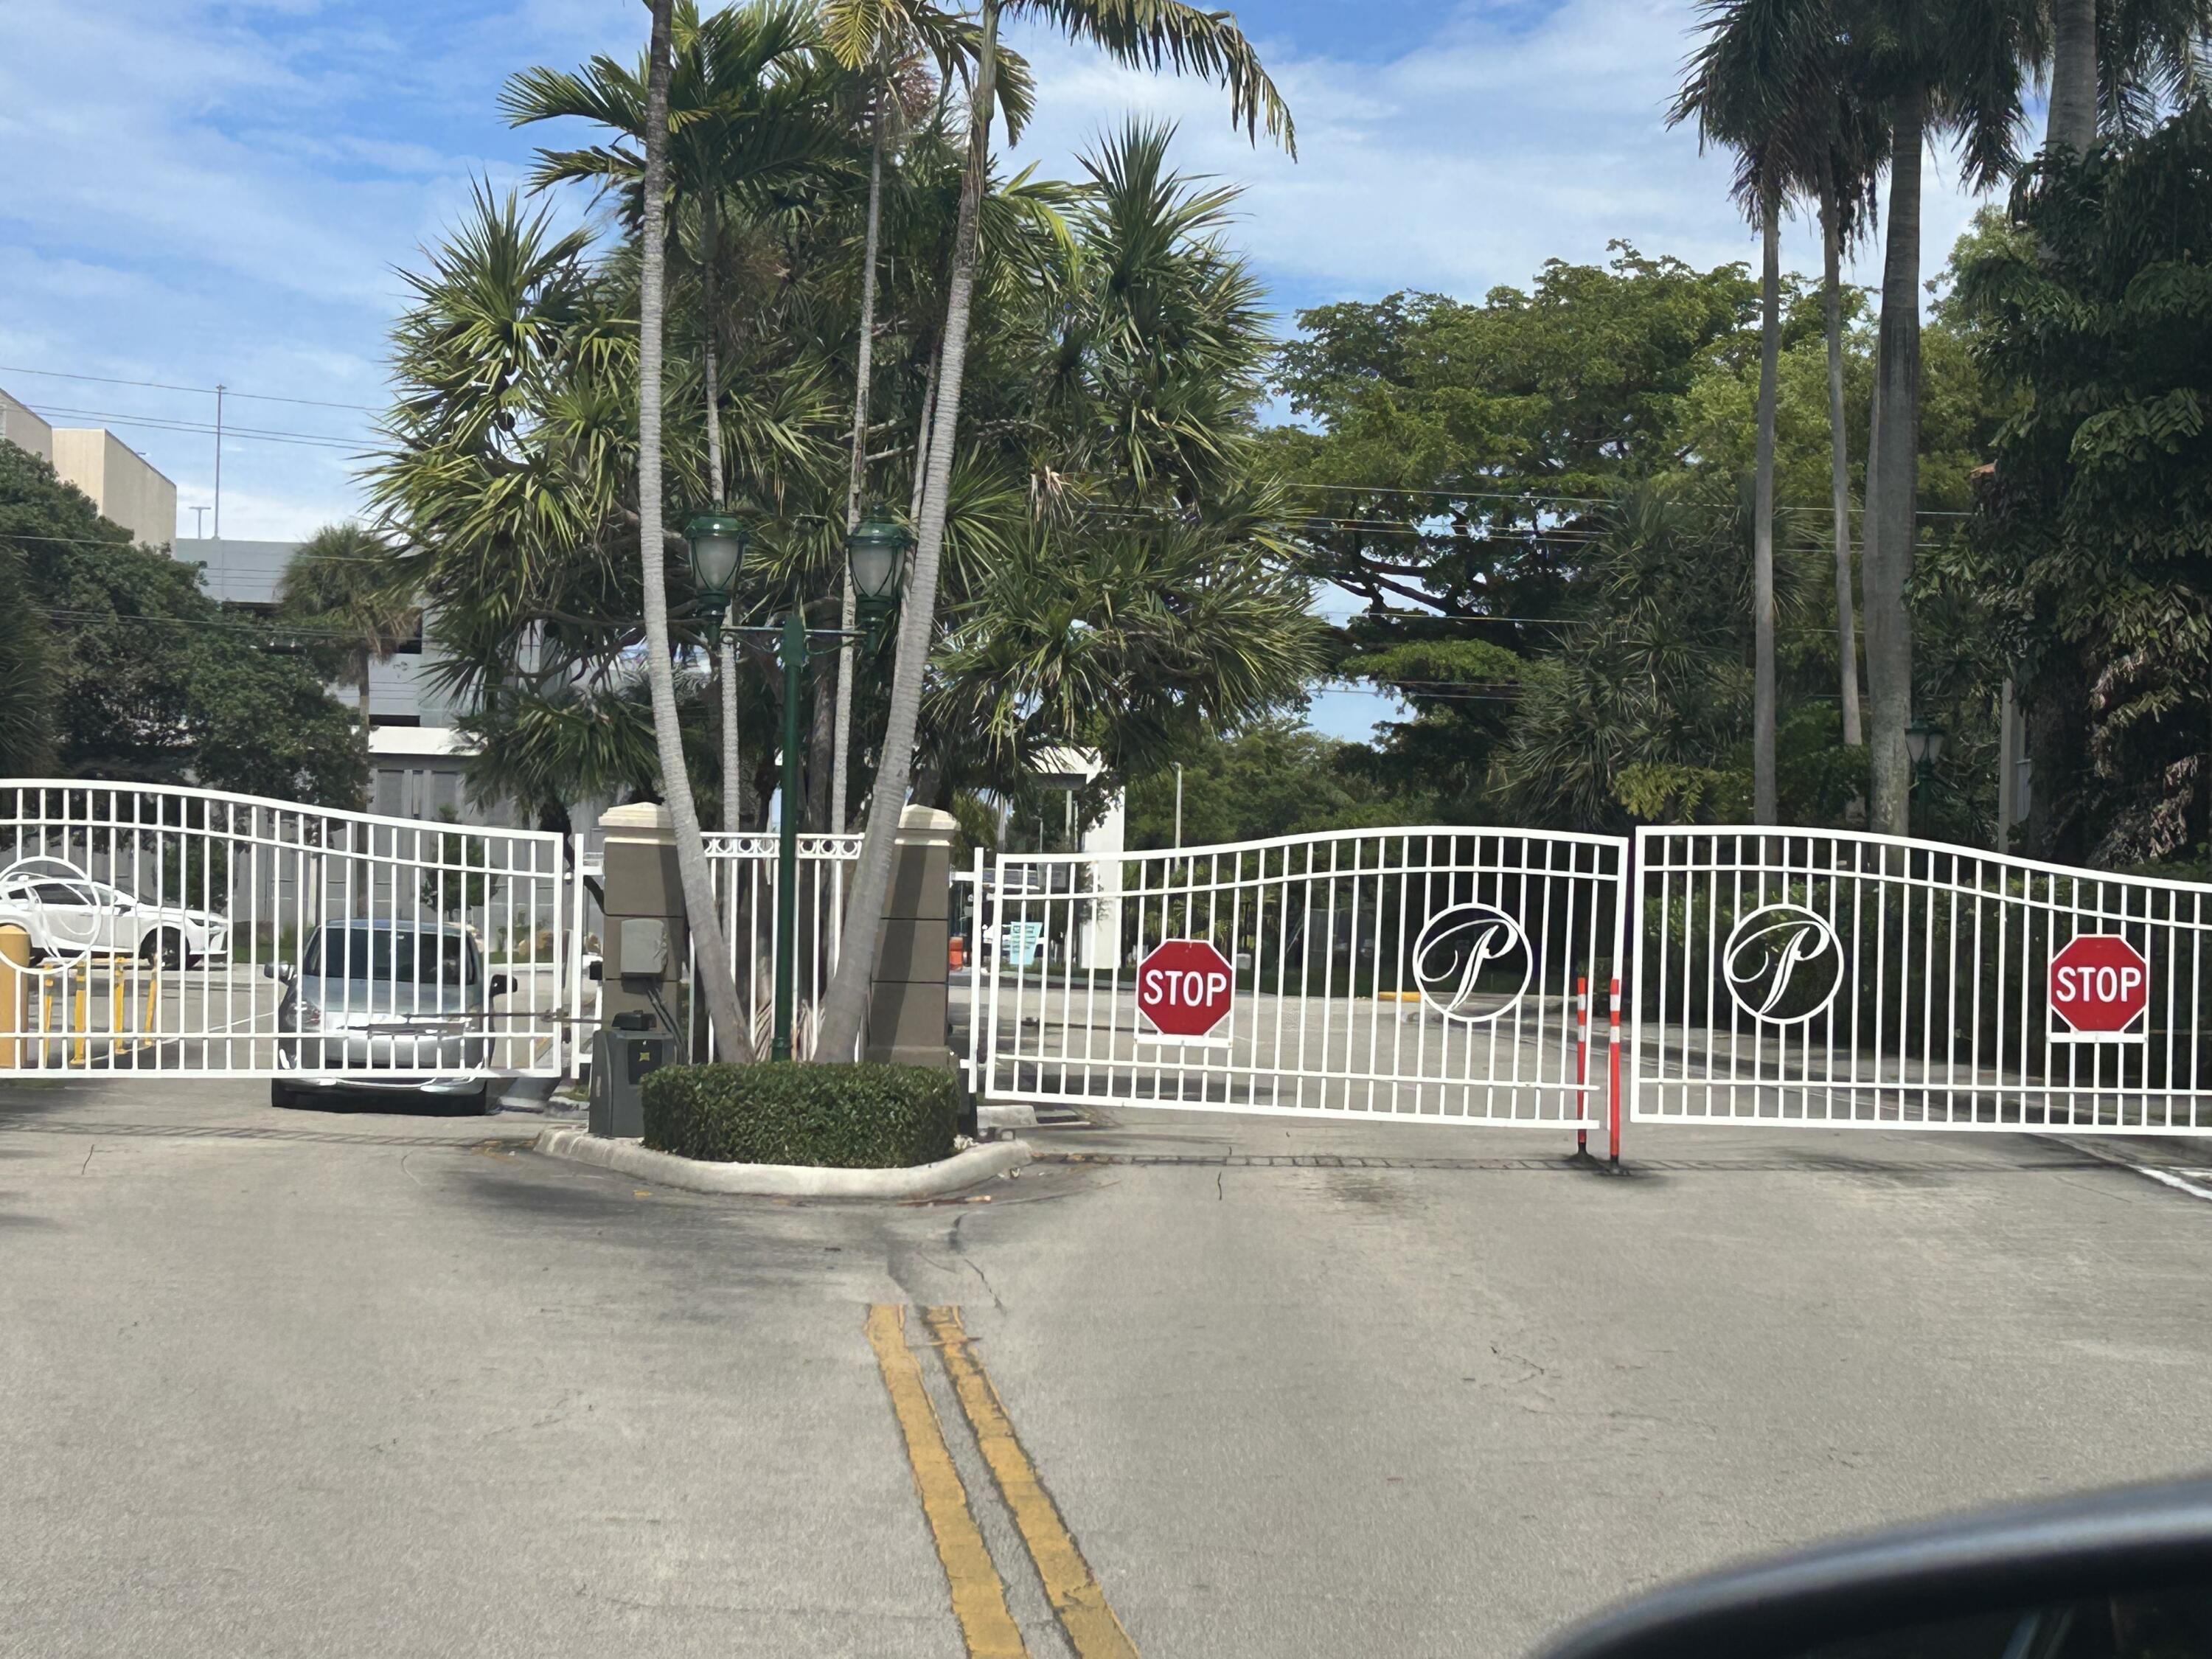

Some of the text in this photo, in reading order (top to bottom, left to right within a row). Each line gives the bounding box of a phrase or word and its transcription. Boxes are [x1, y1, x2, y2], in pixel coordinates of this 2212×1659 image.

[1144, 969, 1227, 1007] STOP
[1418, 918, 1518, 1012] P
[1728, 920, 1830, 1014] P
[2056, 966, 2141, 1003] STOP
